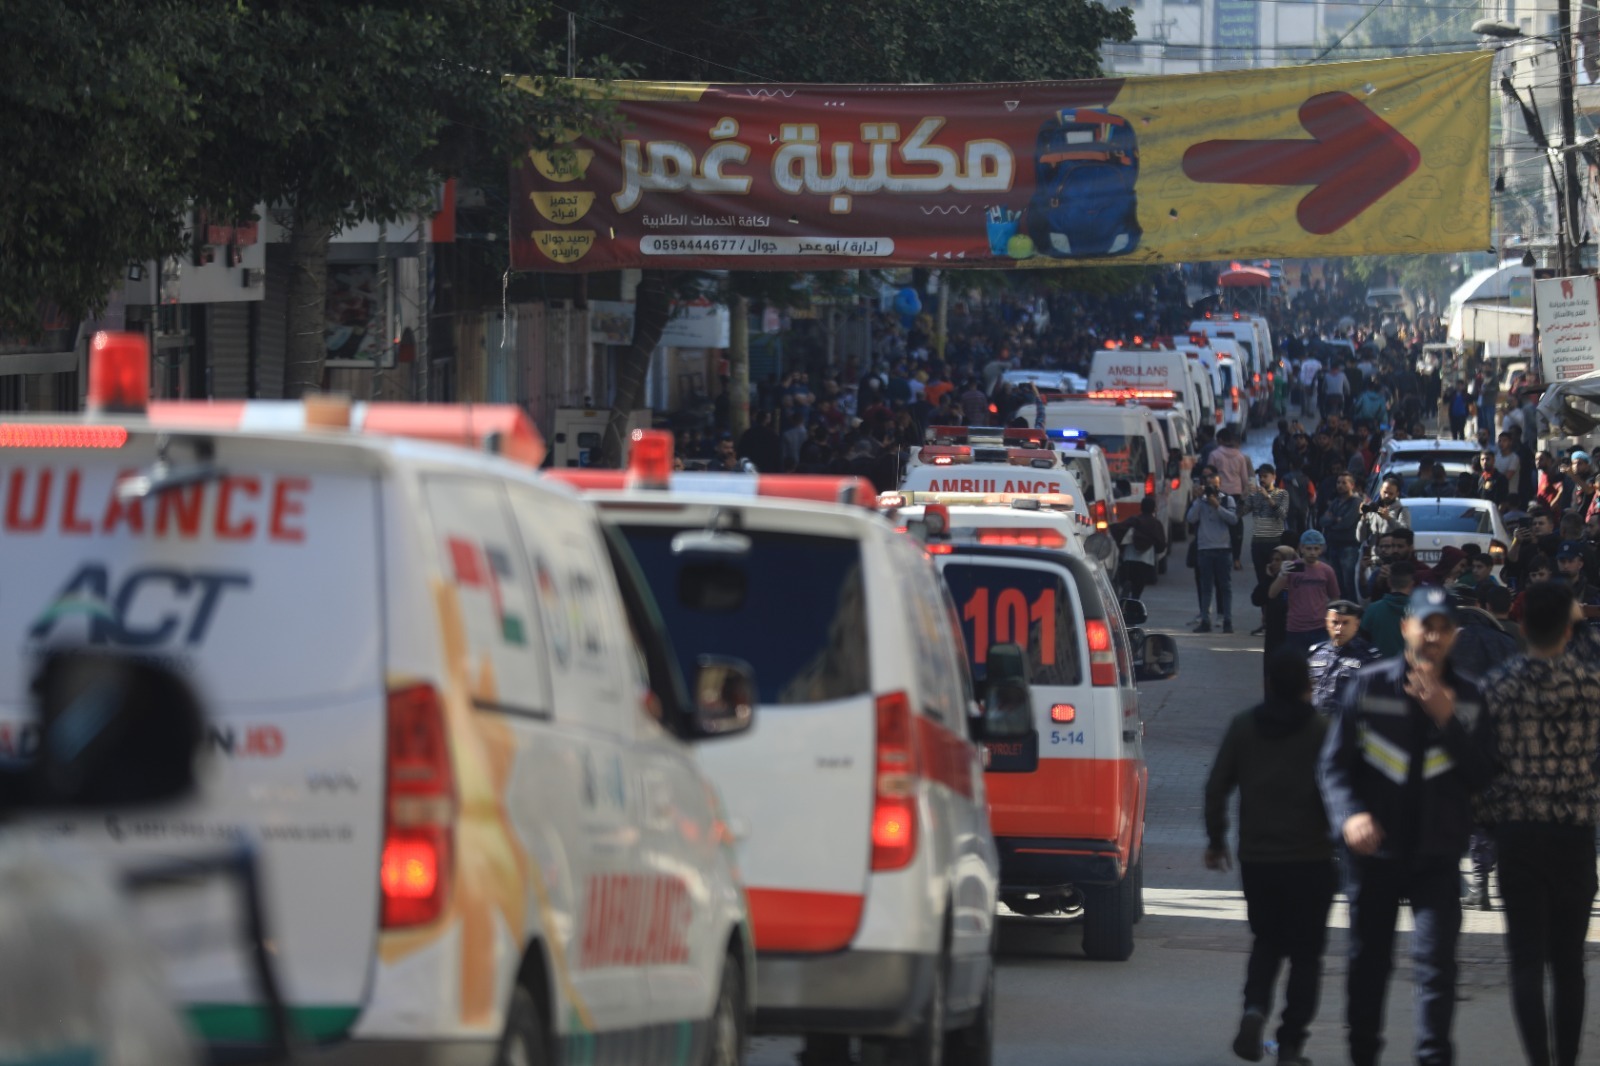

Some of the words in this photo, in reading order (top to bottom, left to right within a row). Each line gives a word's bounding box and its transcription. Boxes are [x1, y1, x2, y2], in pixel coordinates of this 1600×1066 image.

[772, 117, 1015, 213] مكتبة
[550, 195, 578, 207] تجهيز
[642, 214, 688, 228] الطلابية
[690, 215, 736, 227] الخدمات
[738, 216, 770, 228] لكافة
[541, 233, 564, 246] جوال
[567, 235, 590, 246] رصيد
[653, 239, 737, 251] 0594444677
[748, 239, 778, 253] جوال
[798, 243, 822, 253] عمر
[851, 241, 878, 254] إدارة
[1107, 366, 1169, 376] AMBULANS
[928, 479, 1061, 494] AMBULANCE
[28, 561, 253, 646] ACT
[963, 587, 1055, 665] 101
[1051, 731, 1085, 745] 5-14
